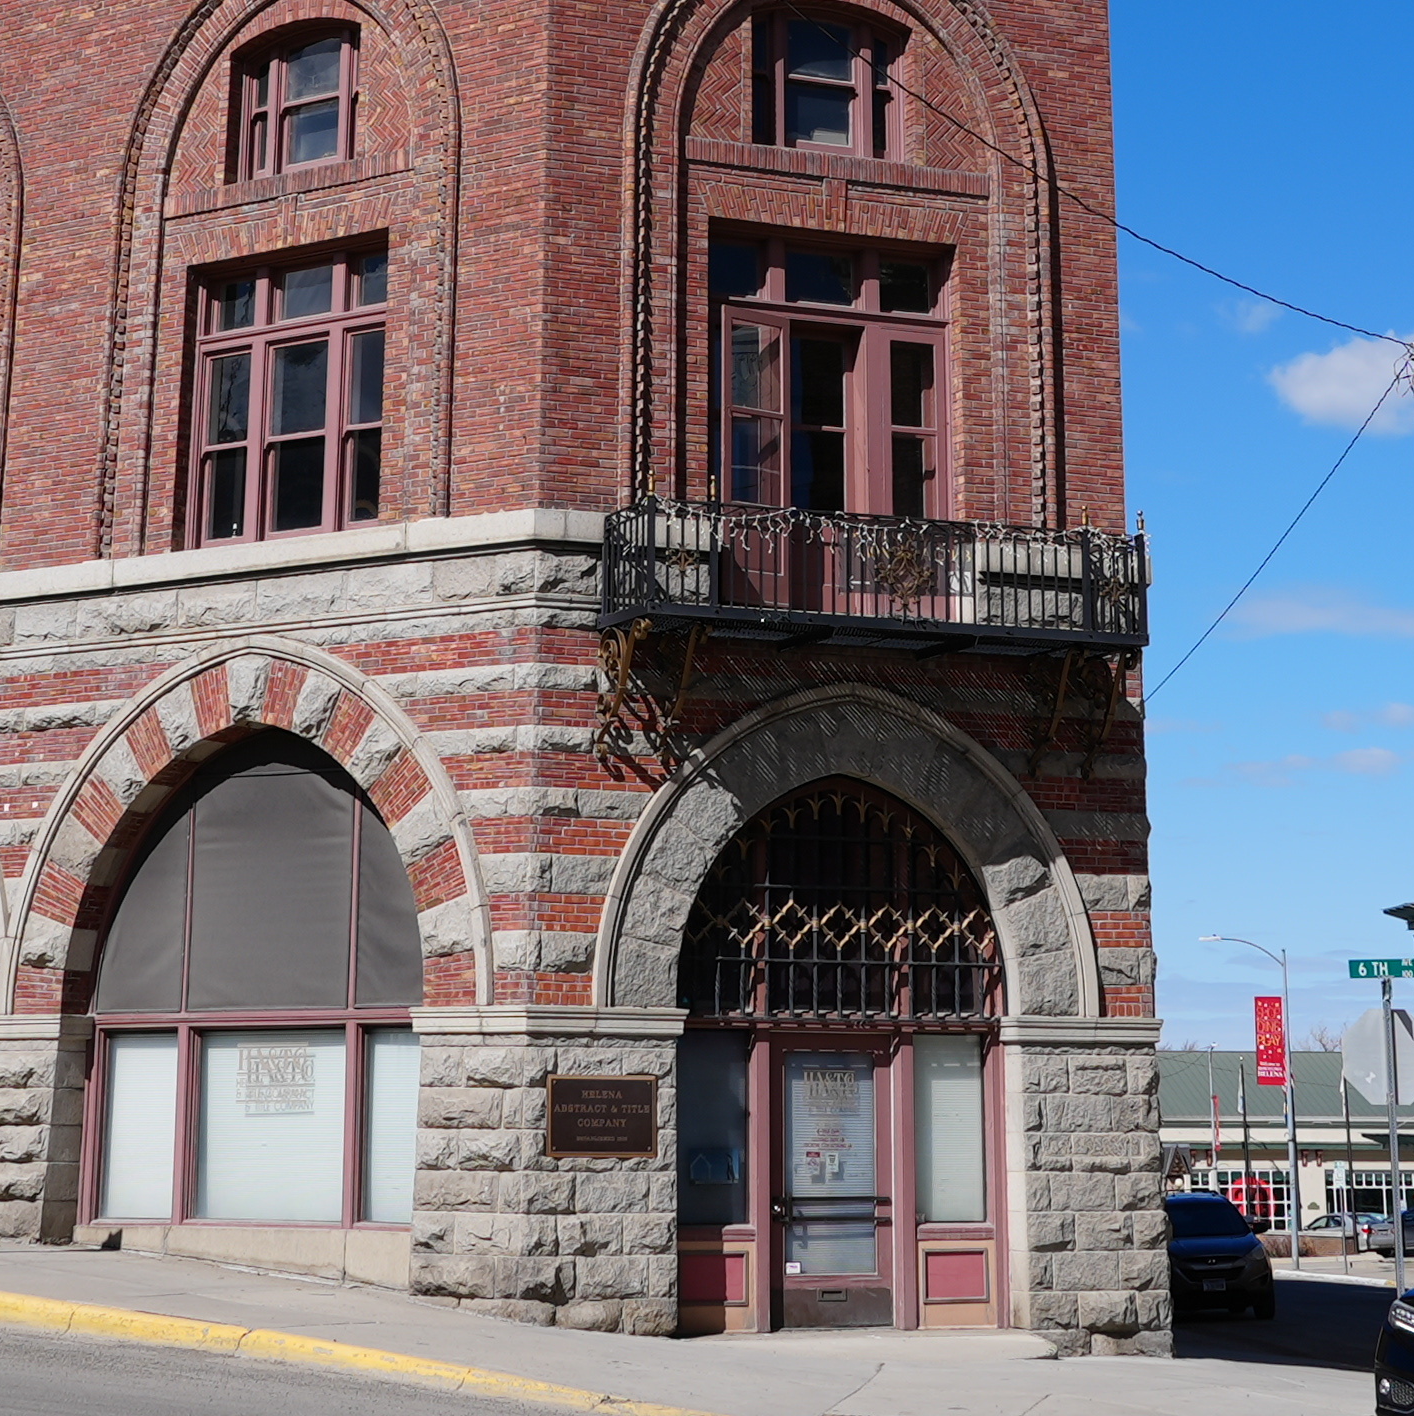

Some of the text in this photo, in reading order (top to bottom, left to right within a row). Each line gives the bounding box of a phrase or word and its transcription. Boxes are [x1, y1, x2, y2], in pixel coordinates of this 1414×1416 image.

[1358, 961, 1388, 976] 6 TH
[1258, 1034, 1281, 1046] PLAY
[581, 1090, 622, 1099] HELENA
[554, 1104, 607, 1113] ABSTRACT
[622, 1105, 650, 1113] TITLE
[577, 1119, 626, 1127] COMPANY
